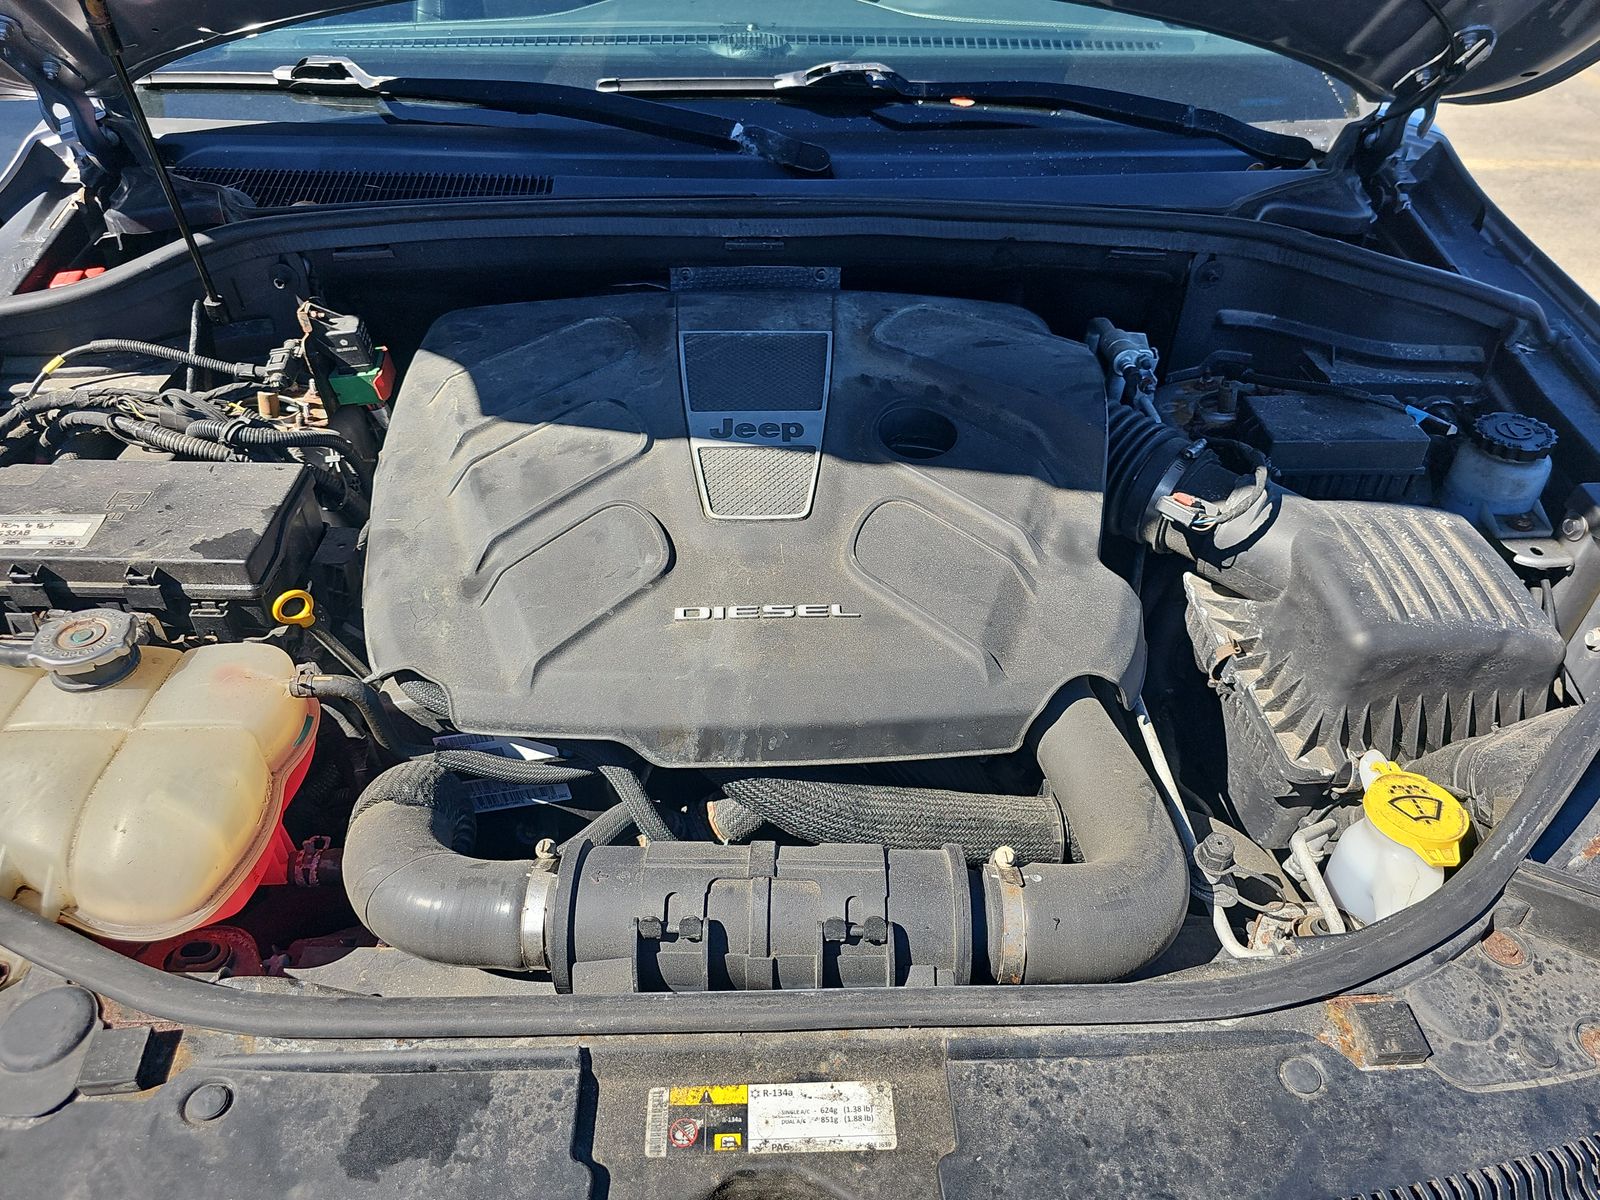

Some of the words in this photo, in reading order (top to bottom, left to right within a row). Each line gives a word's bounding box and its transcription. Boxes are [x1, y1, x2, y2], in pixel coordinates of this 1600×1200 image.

[709, 418, 805, 442] Jeep
[674, 604, 862, 620] DIESEL
[763, 1088, 793, 1097] R-134a
[820, 1107, 838, 1115] 624g
[843, 1105, 862, 1113] (1.38
[863, 1104, 874, 1113] lb)
[820, 1116, 839, 1124] 851g
[844, 1115, 863, 1124] (1.88
[864, 1114, 874, 1123] lb)
